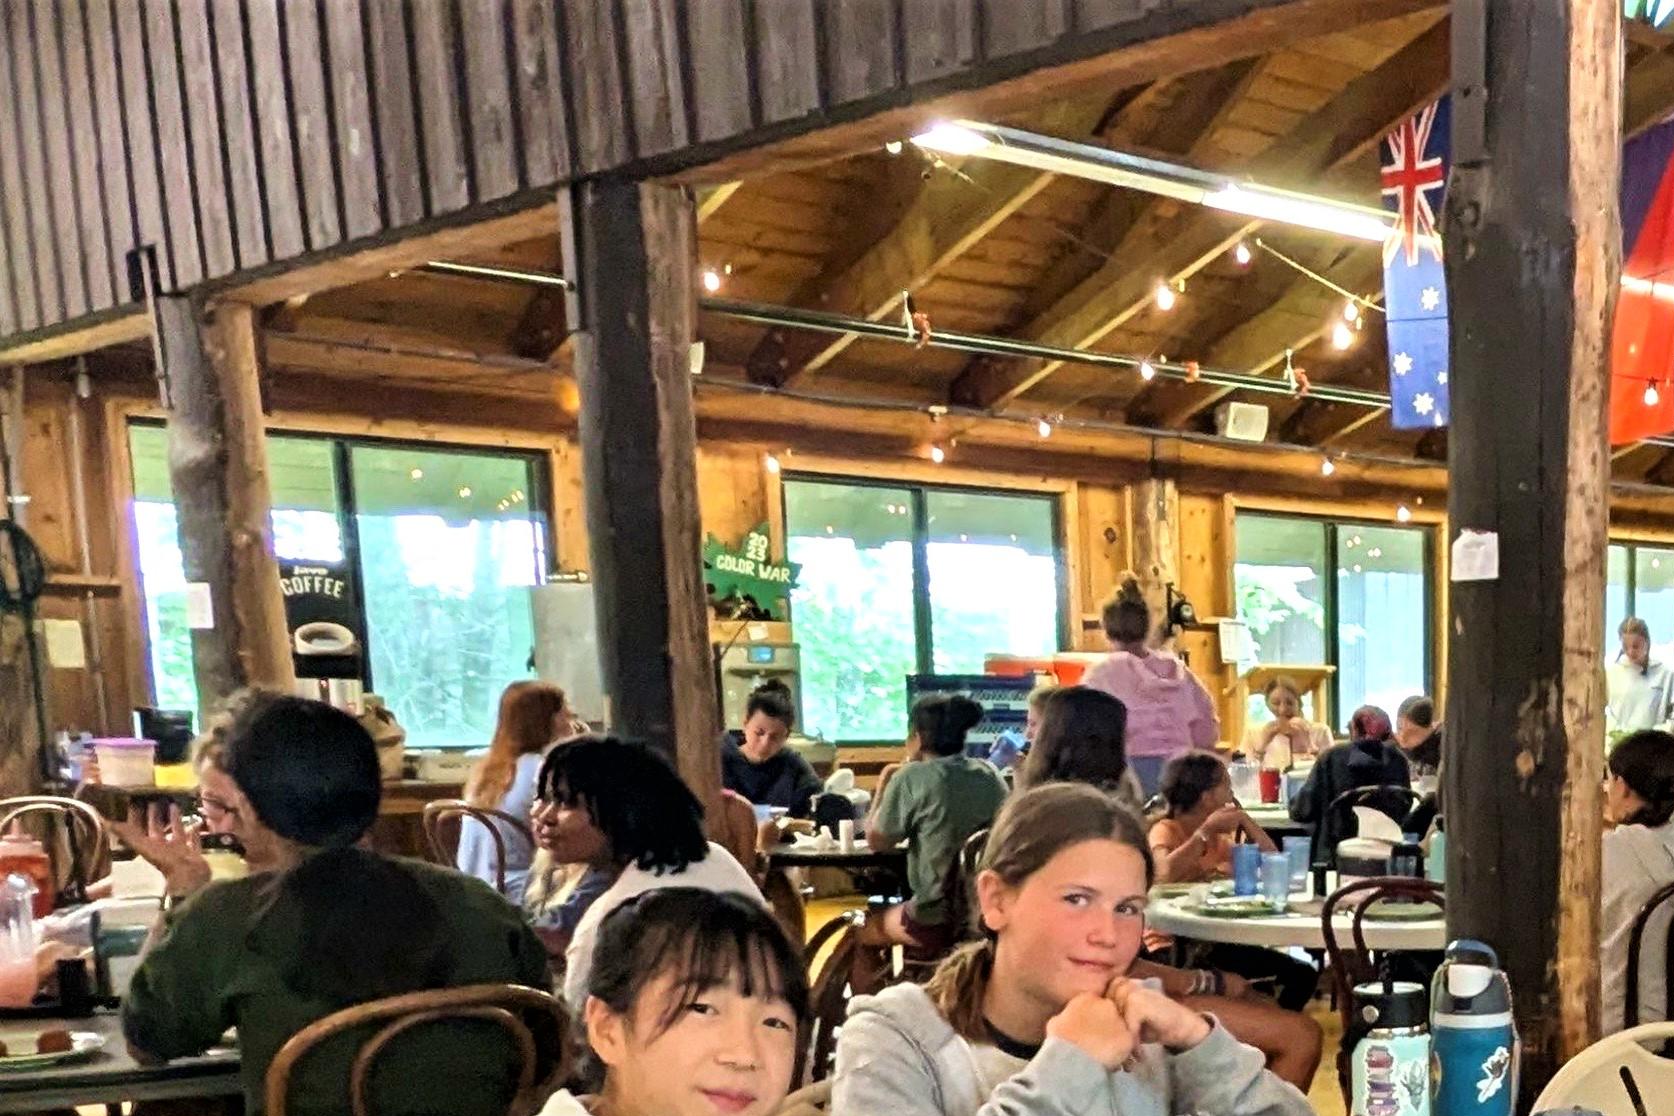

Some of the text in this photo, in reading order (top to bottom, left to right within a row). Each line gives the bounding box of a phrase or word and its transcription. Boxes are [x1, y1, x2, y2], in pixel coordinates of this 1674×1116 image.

[748, 532, 768, 549] 20
[746, 546, 766, 562] 23
[716, 555, 791, 583] COLOR WAR
[280, 576, 344, 599] COFFEE
